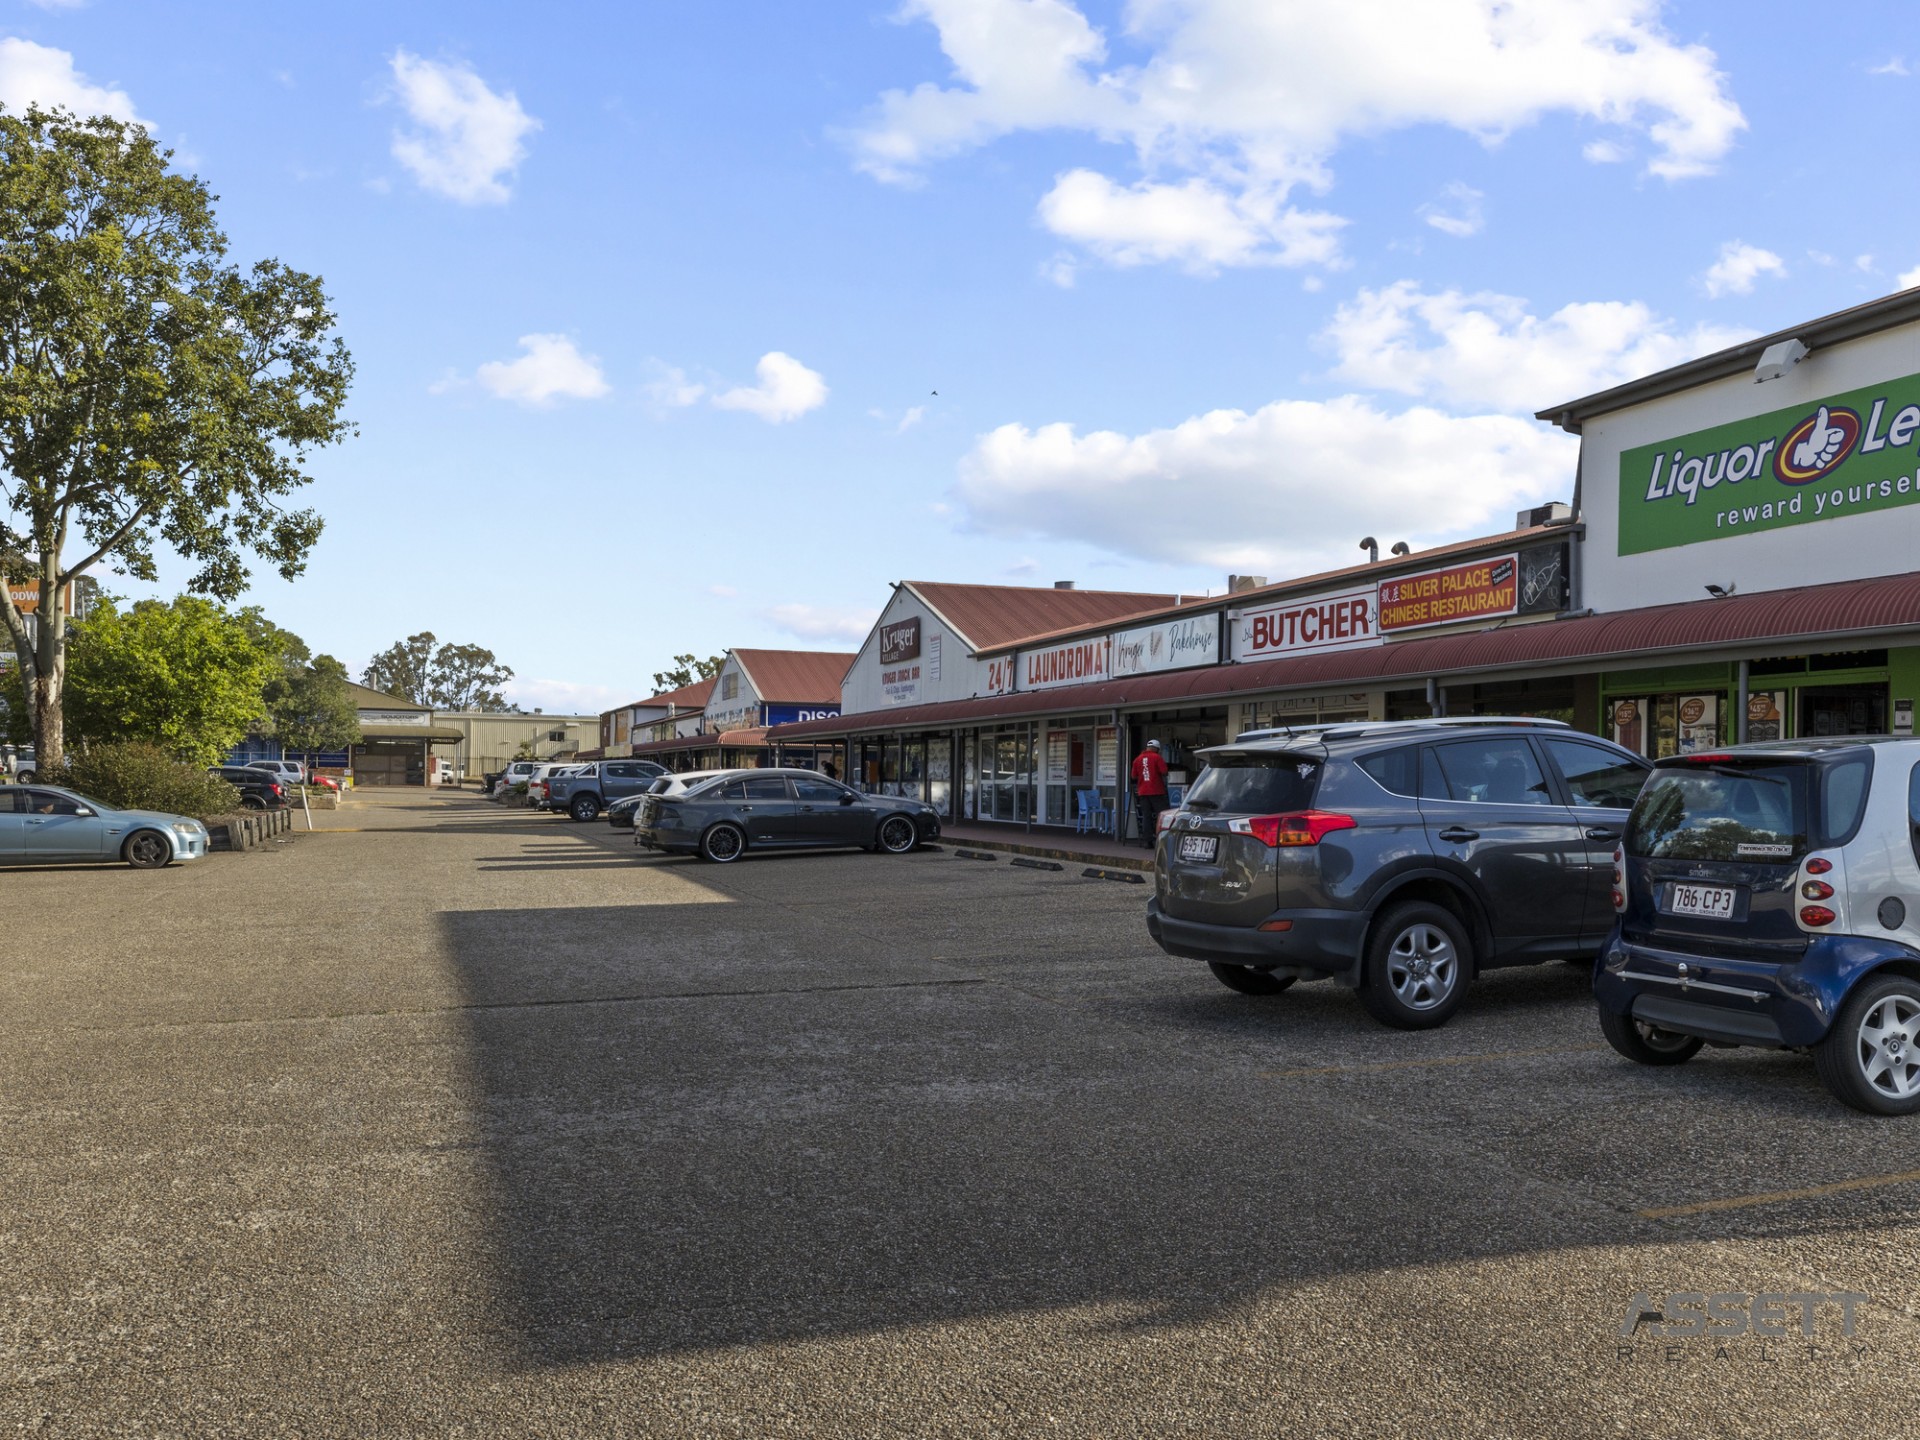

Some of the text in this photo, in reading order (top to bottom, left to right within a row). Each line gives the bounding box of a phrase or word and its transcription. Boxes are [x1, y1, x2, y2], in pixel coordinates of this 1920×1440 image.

[1645, 437, 1776, 505] Liquor
[1716, 493, 1802, 528] reward
[1400, 568, 1490, 600] SILVER PALACE
[1252, 599, 1369, 650] BUTCHER
[1381, 588, 1514, 625] CHINESE RESTAURANT
[882, 627, 915, 653] Kruger
[882, 651, 899, 663] VILLAGE
[1168, 622, 1214, 662] Bakehouse
[988, 640, 1112, 691] 24/7 LAUNDROMAT
[1688, 869, 1710, 878] smart
